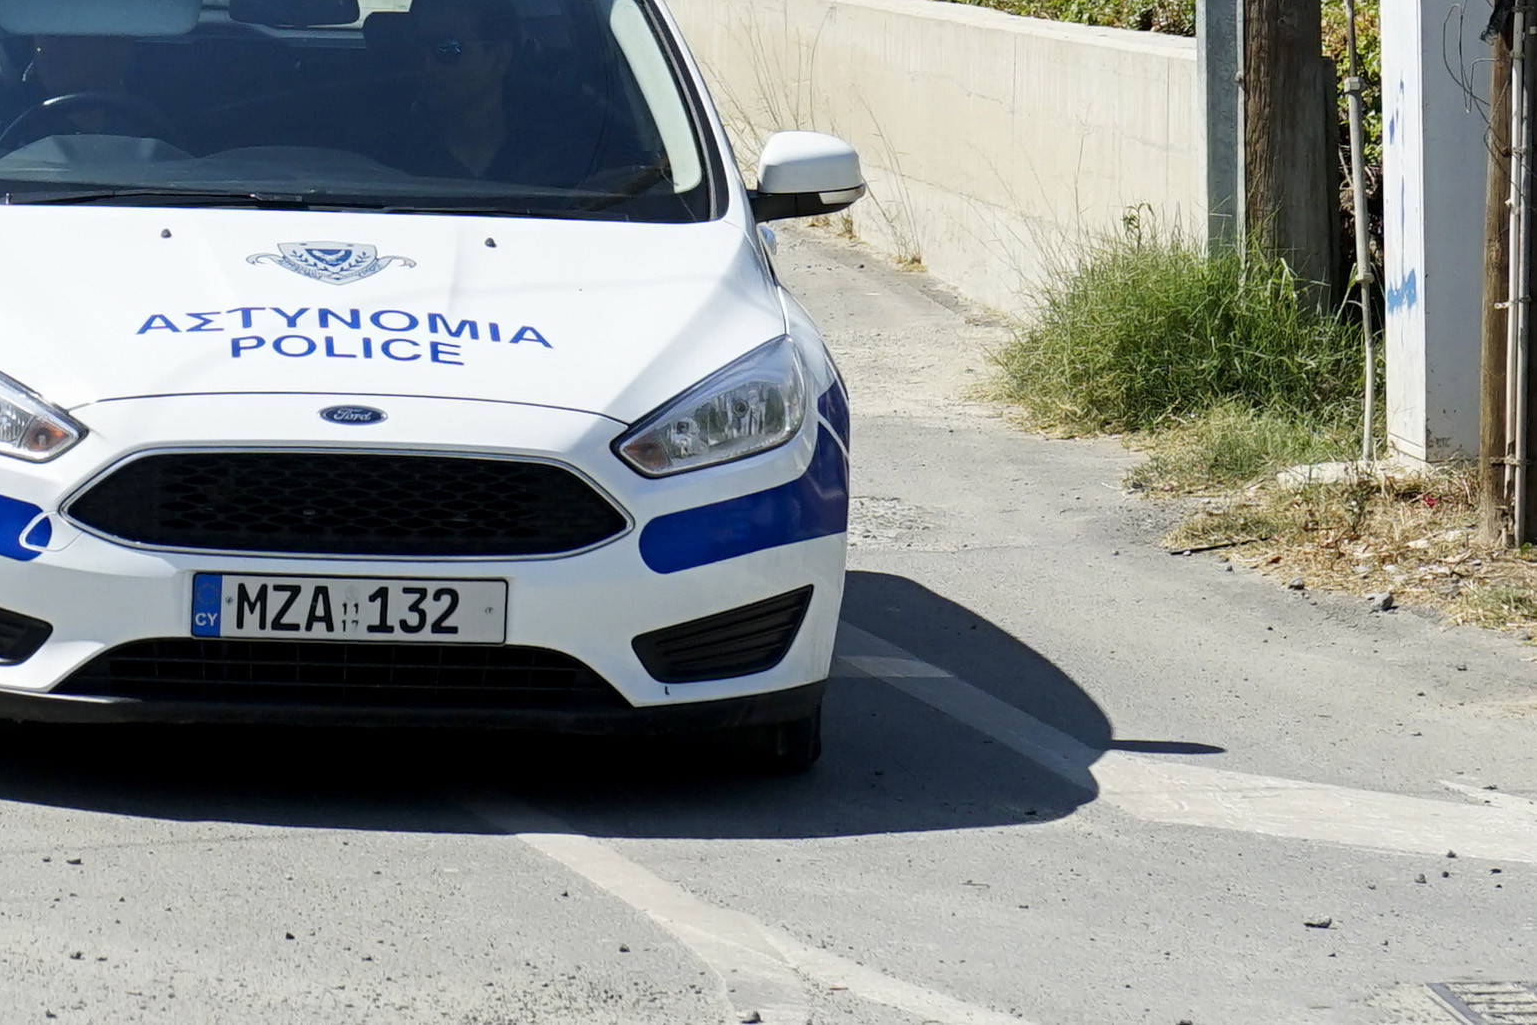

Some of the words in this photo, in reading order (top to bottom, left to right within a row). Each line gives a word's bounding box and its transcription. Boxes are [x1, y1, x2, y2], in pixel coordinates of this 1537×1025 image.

[135, 307, 554, 349] ΑΣΤΥΝΟΜΙΑ
[230, 334, 465, 366] POLICE
[333, 408, 372, 422] Ford
[194, 612, 218, 627] CY
[235, 582, 335, 633] MZA
[366, 586, 460, 635] 132
